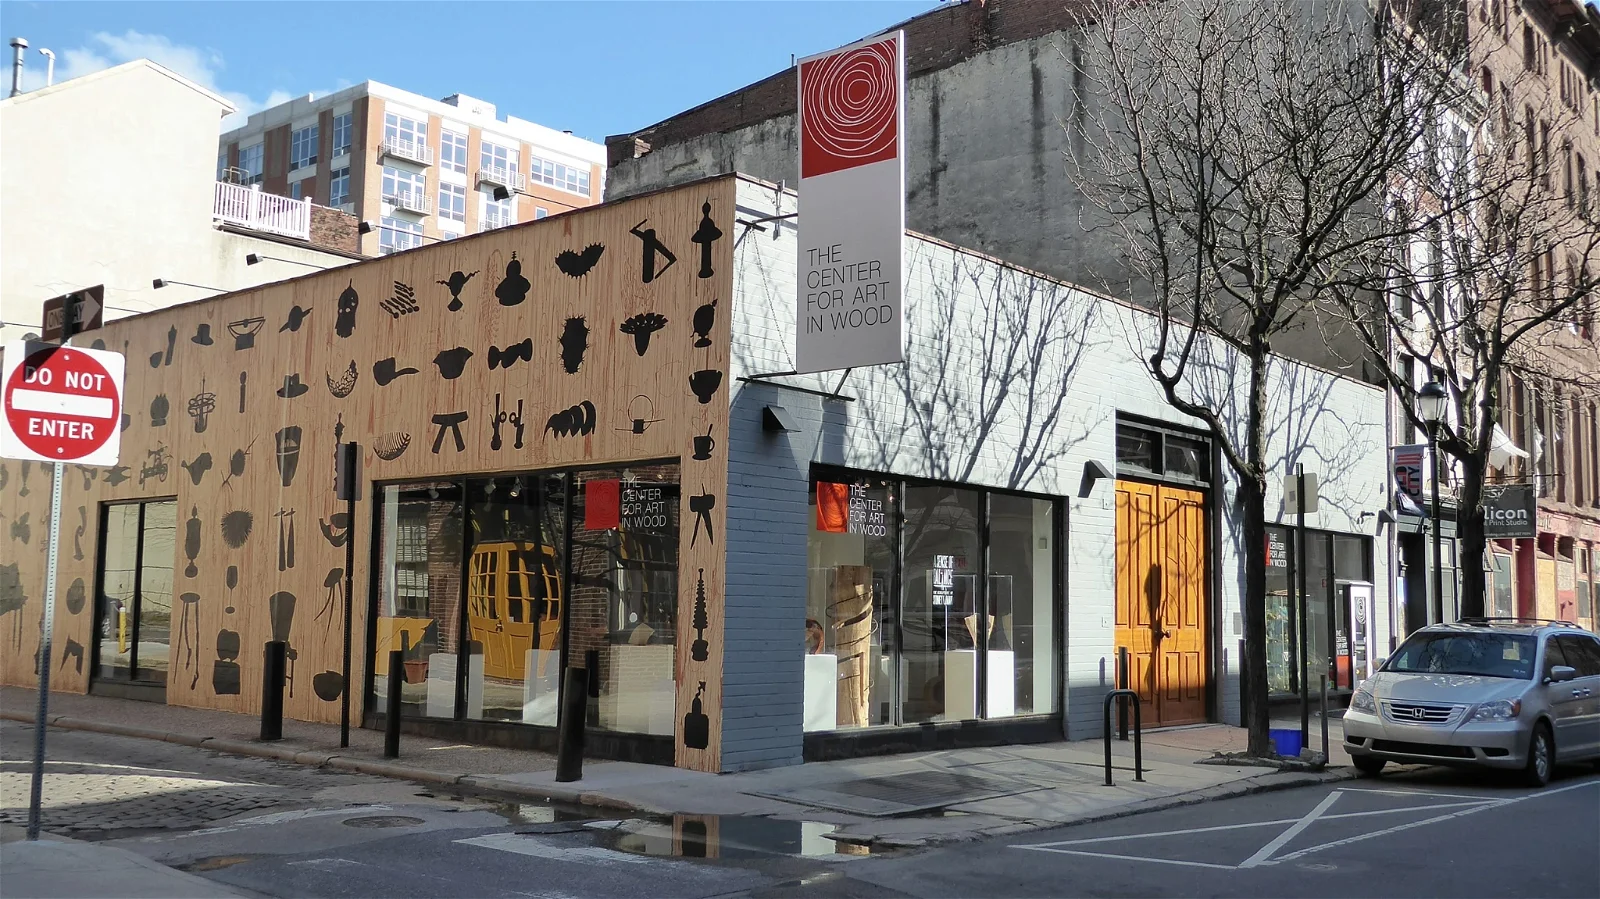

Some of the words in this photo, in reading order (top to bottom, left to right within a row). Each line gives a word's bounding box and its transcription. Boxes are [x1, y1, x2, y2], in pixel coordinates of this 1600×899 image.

[807, 244, 843, 267] THE
[806, 260, 881, 289] CENTER
[806, 288, 844, 311] FOR
[852, 281, 891, 306] ART
[806, 314, 823, 335] IN
[830, 305, 893, 331] WOOD
[25, 365, 53, 385] DO
[65, 371, 106, 392] NOT
[29, 418, 95, 441] ENTER
[622, 477, 641, 488] THE
[622, 488, 662, 502] CENTER
[849, 484, 867, 497] THE
[622, 503, 642, 515] FOR
[645, 501, 665, 514] ART
[849, 497, 882, 511] CENTER
[849, 510, 866, 522] FOR
[869, 511, 885, 524] ART
[1483, 505, 1528, 520] licon
[622, 517, 631, 528] IN
[634, 515, 667, 528] WOOD
[849, 524, 858, 535] IN
[859, 524, 886, 537] WOOD
